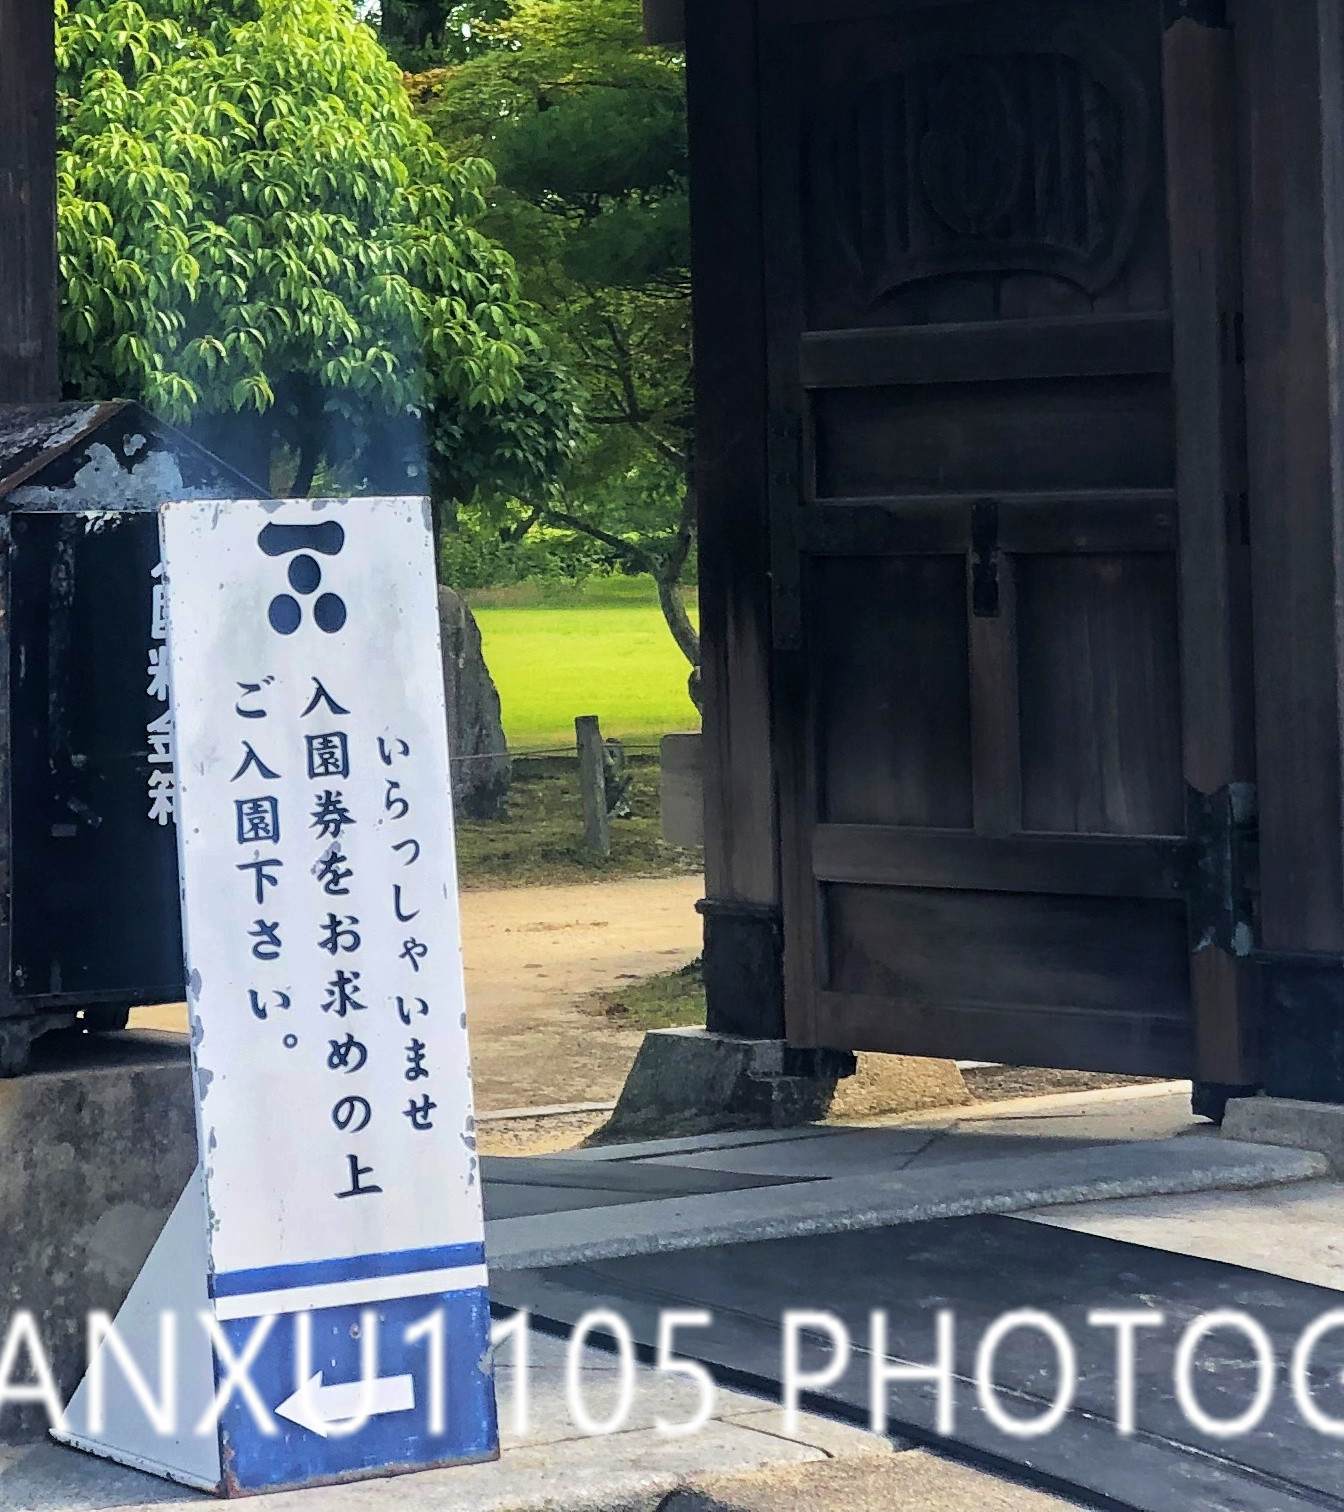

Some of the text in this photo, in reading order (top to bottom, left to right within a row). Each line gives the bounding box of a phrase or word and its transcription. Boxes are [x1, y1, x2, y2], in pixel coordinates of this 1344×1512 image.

[229, 675, 299, 1051] ご入園下さい。
[299, 675, 384, 1200] 入園券をお求めの上
[376, 734, 438, 1133] いらっしゃいませ
